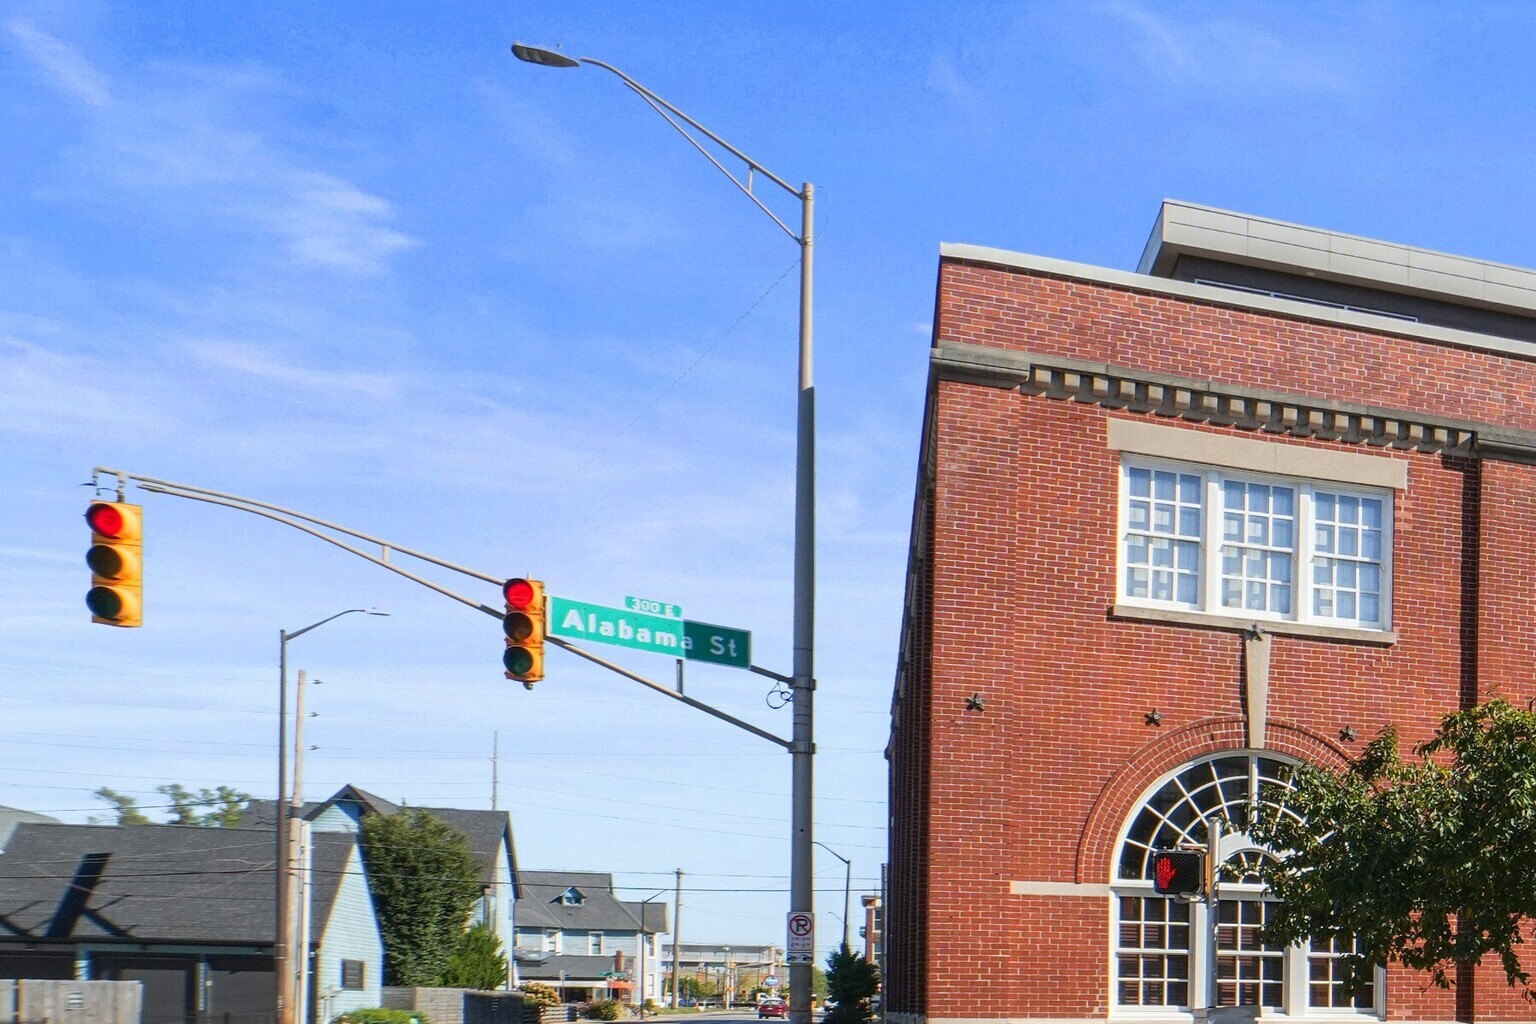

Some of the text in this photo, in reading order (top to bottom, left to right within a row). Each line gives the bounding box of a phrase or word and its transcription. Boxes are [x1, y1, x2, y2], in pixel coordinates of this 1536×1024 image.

[632, 599, 675, 618] 300 E
[562, 608, 737, 658] Alabama St
